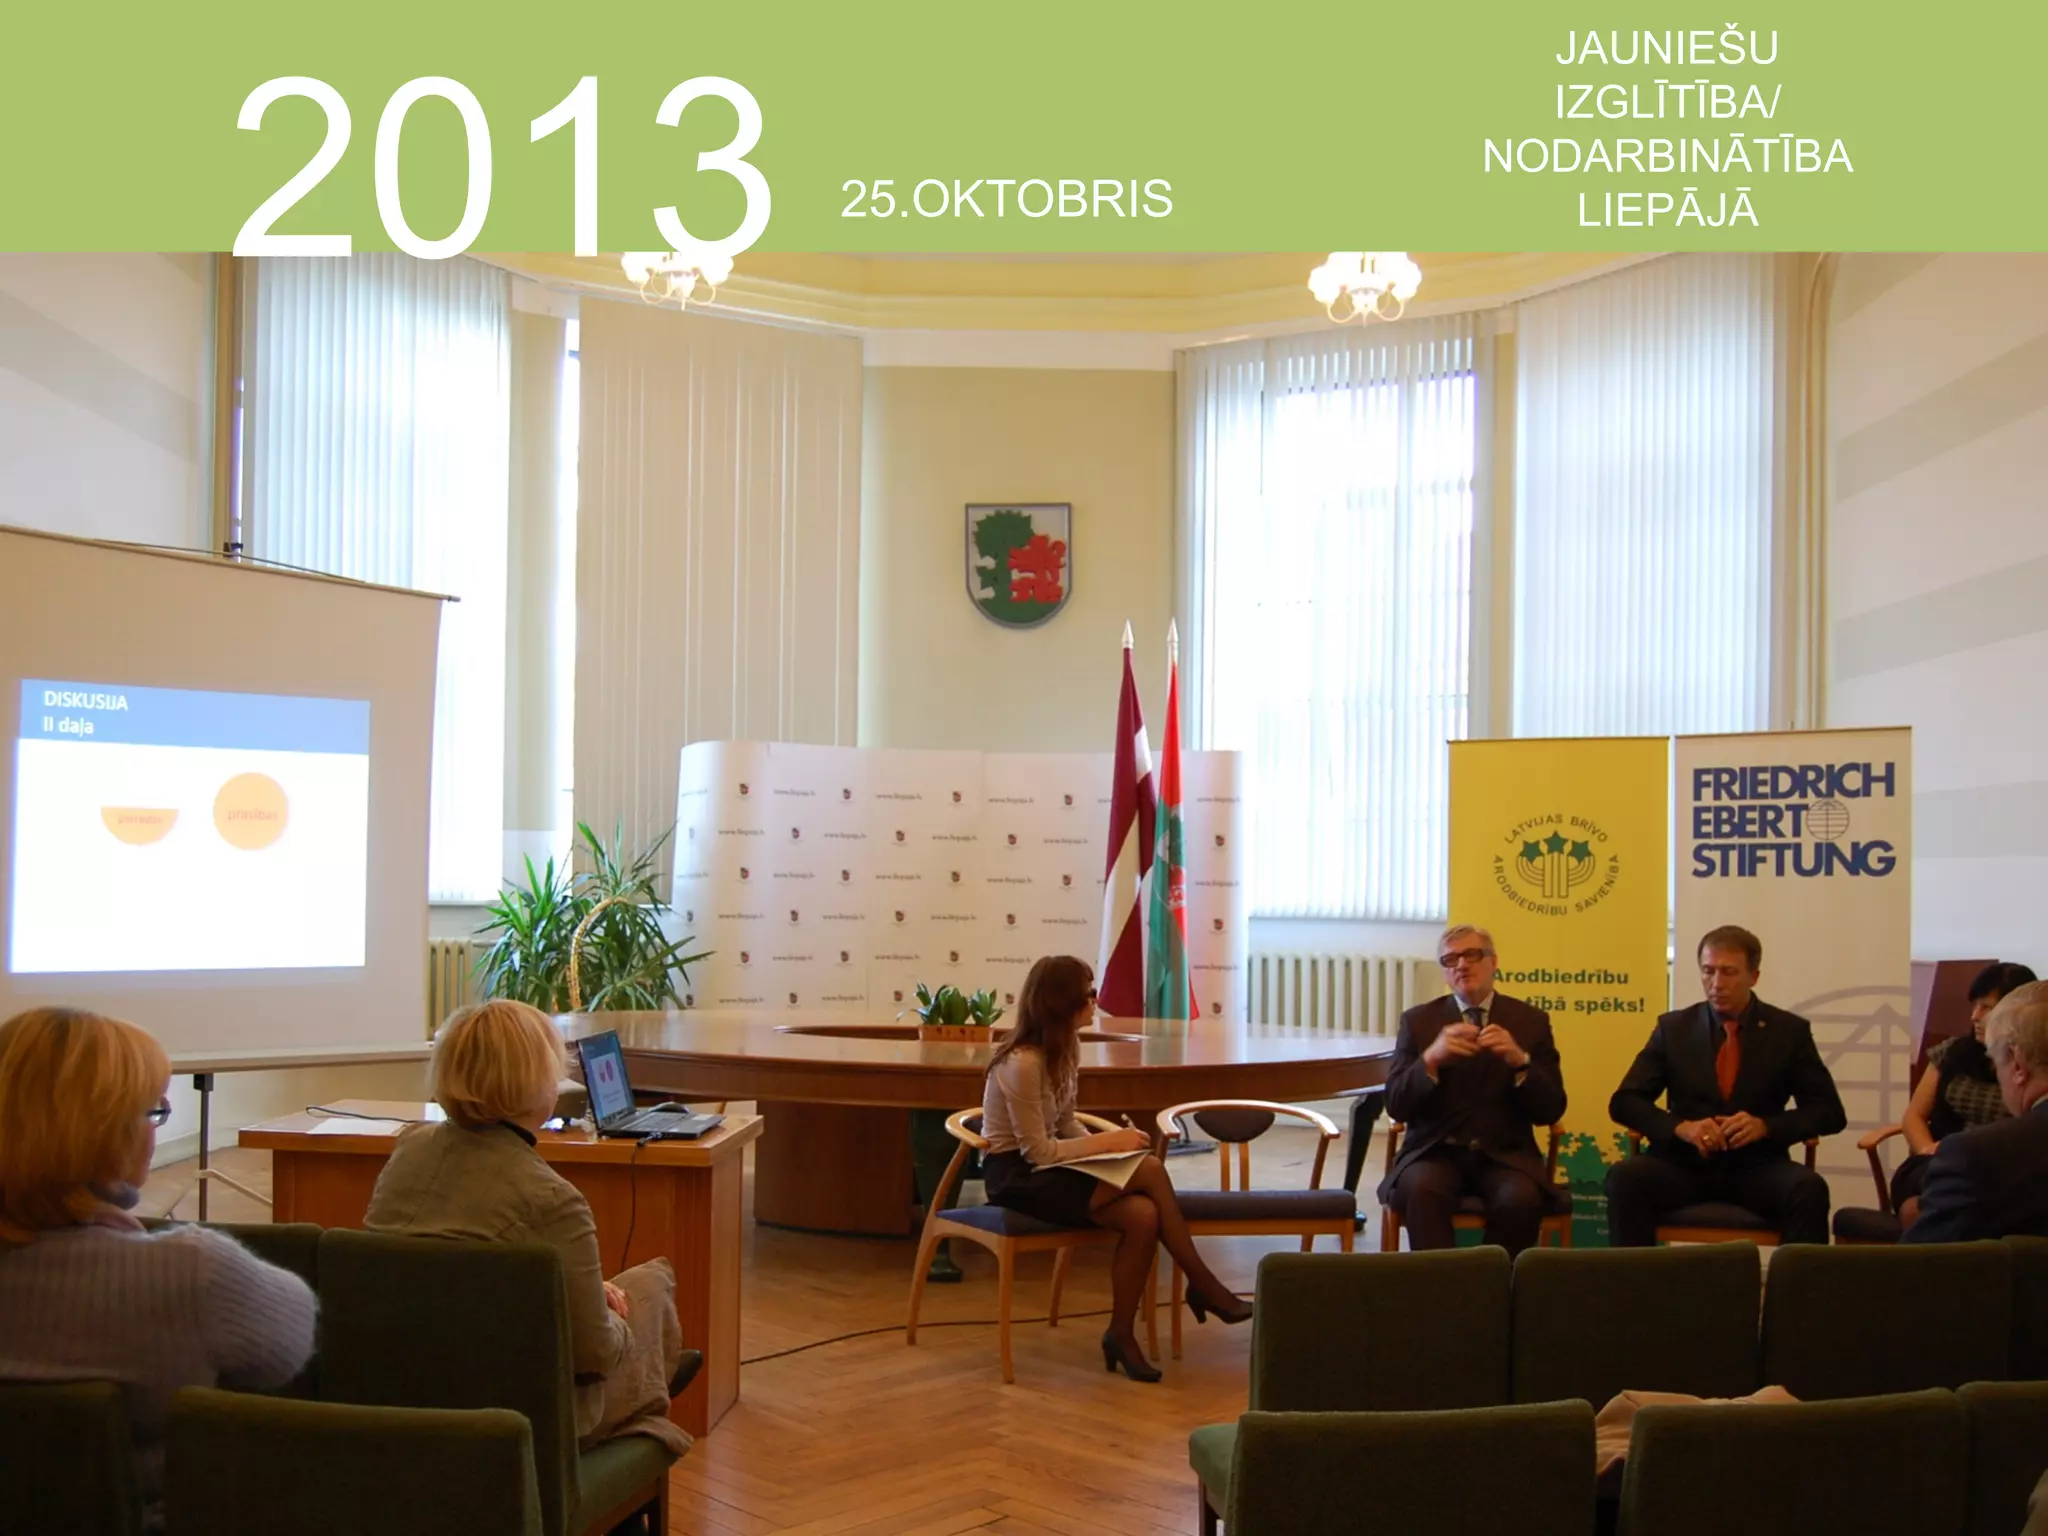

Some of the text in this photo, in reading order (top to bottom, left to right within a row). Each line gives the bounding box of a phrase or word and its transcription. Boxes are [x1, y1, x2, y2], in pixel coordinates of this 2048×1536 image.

[44, 690, 129, 711] DISKUSIJA
[1693, 762, 1895, 801] FRIEDRICH
[1504, 814, 1563, 844] LATVIJAS
[1693, 803, 1809, 839] EBERT
[1692, 839, 1897, 878] STIFTUNG
[1492, 968, 1629, 984] Arodbiedrību
[1574, 997, 1645, 1014] spēks!
